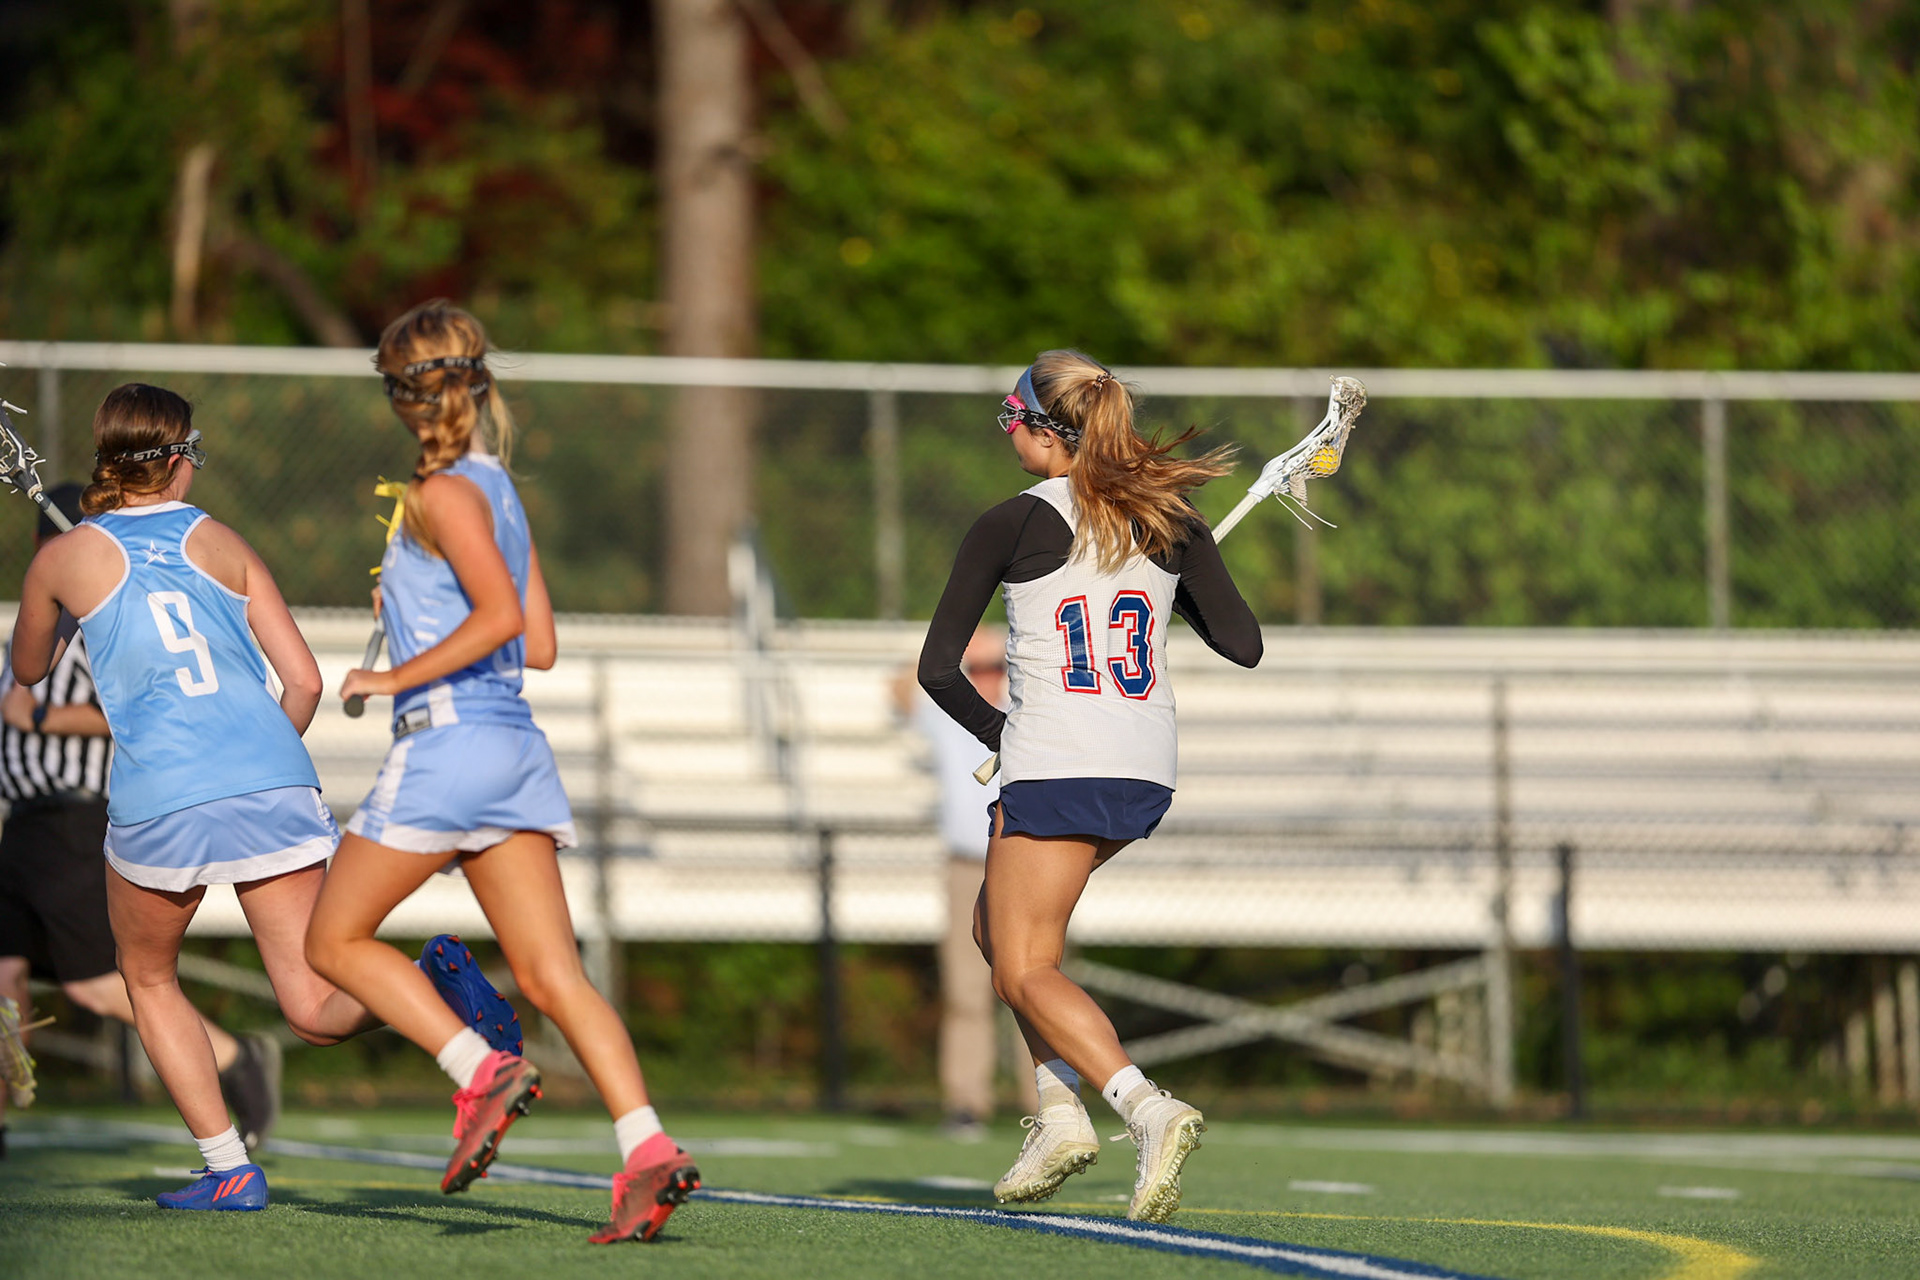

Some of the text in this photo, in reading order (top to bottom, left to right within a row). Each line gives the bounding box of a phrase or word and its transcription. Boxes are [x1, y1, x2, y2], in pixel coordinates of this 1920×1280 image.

[134, 447, 163, 462] STX
[147, 591, 219, 697] 9
[1055, 590, 1156, 700] 13
